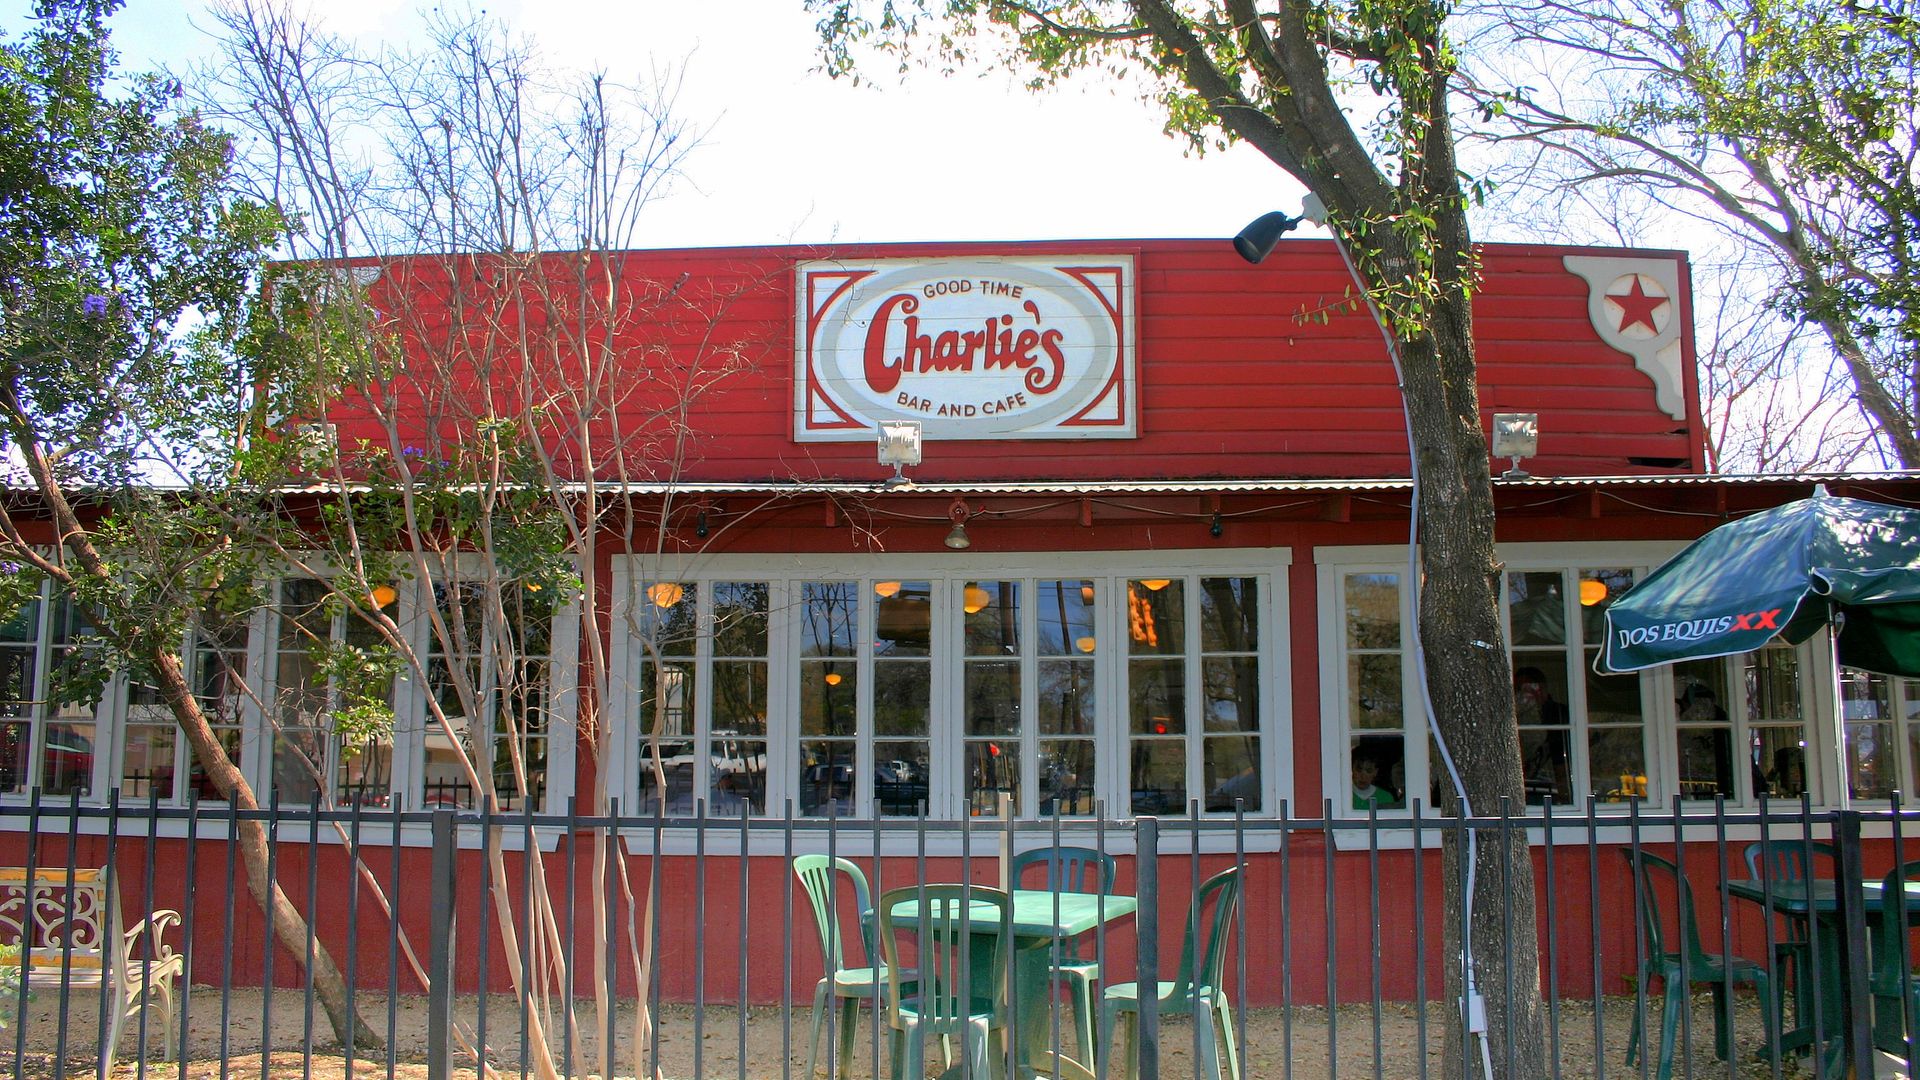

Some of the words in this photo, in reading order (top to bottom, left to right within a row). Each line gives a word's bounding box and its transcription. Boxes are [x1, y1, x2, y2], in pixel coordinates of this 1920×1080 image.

[923, 279, 972, 298] GOOD
[979, 280, 1024, 299] TIME
[864, 293, 1065, 395] Charlie's
[896, 391, 932, 412] BAR
[937, 403, 976, 417] AND
[982, 391, 1027, 414] CAFE
[1619, 627, 1659, 649] DOS
[1661, 616, 1732, 641] EQUIS
[1730, 608, 1782, 632] XX
